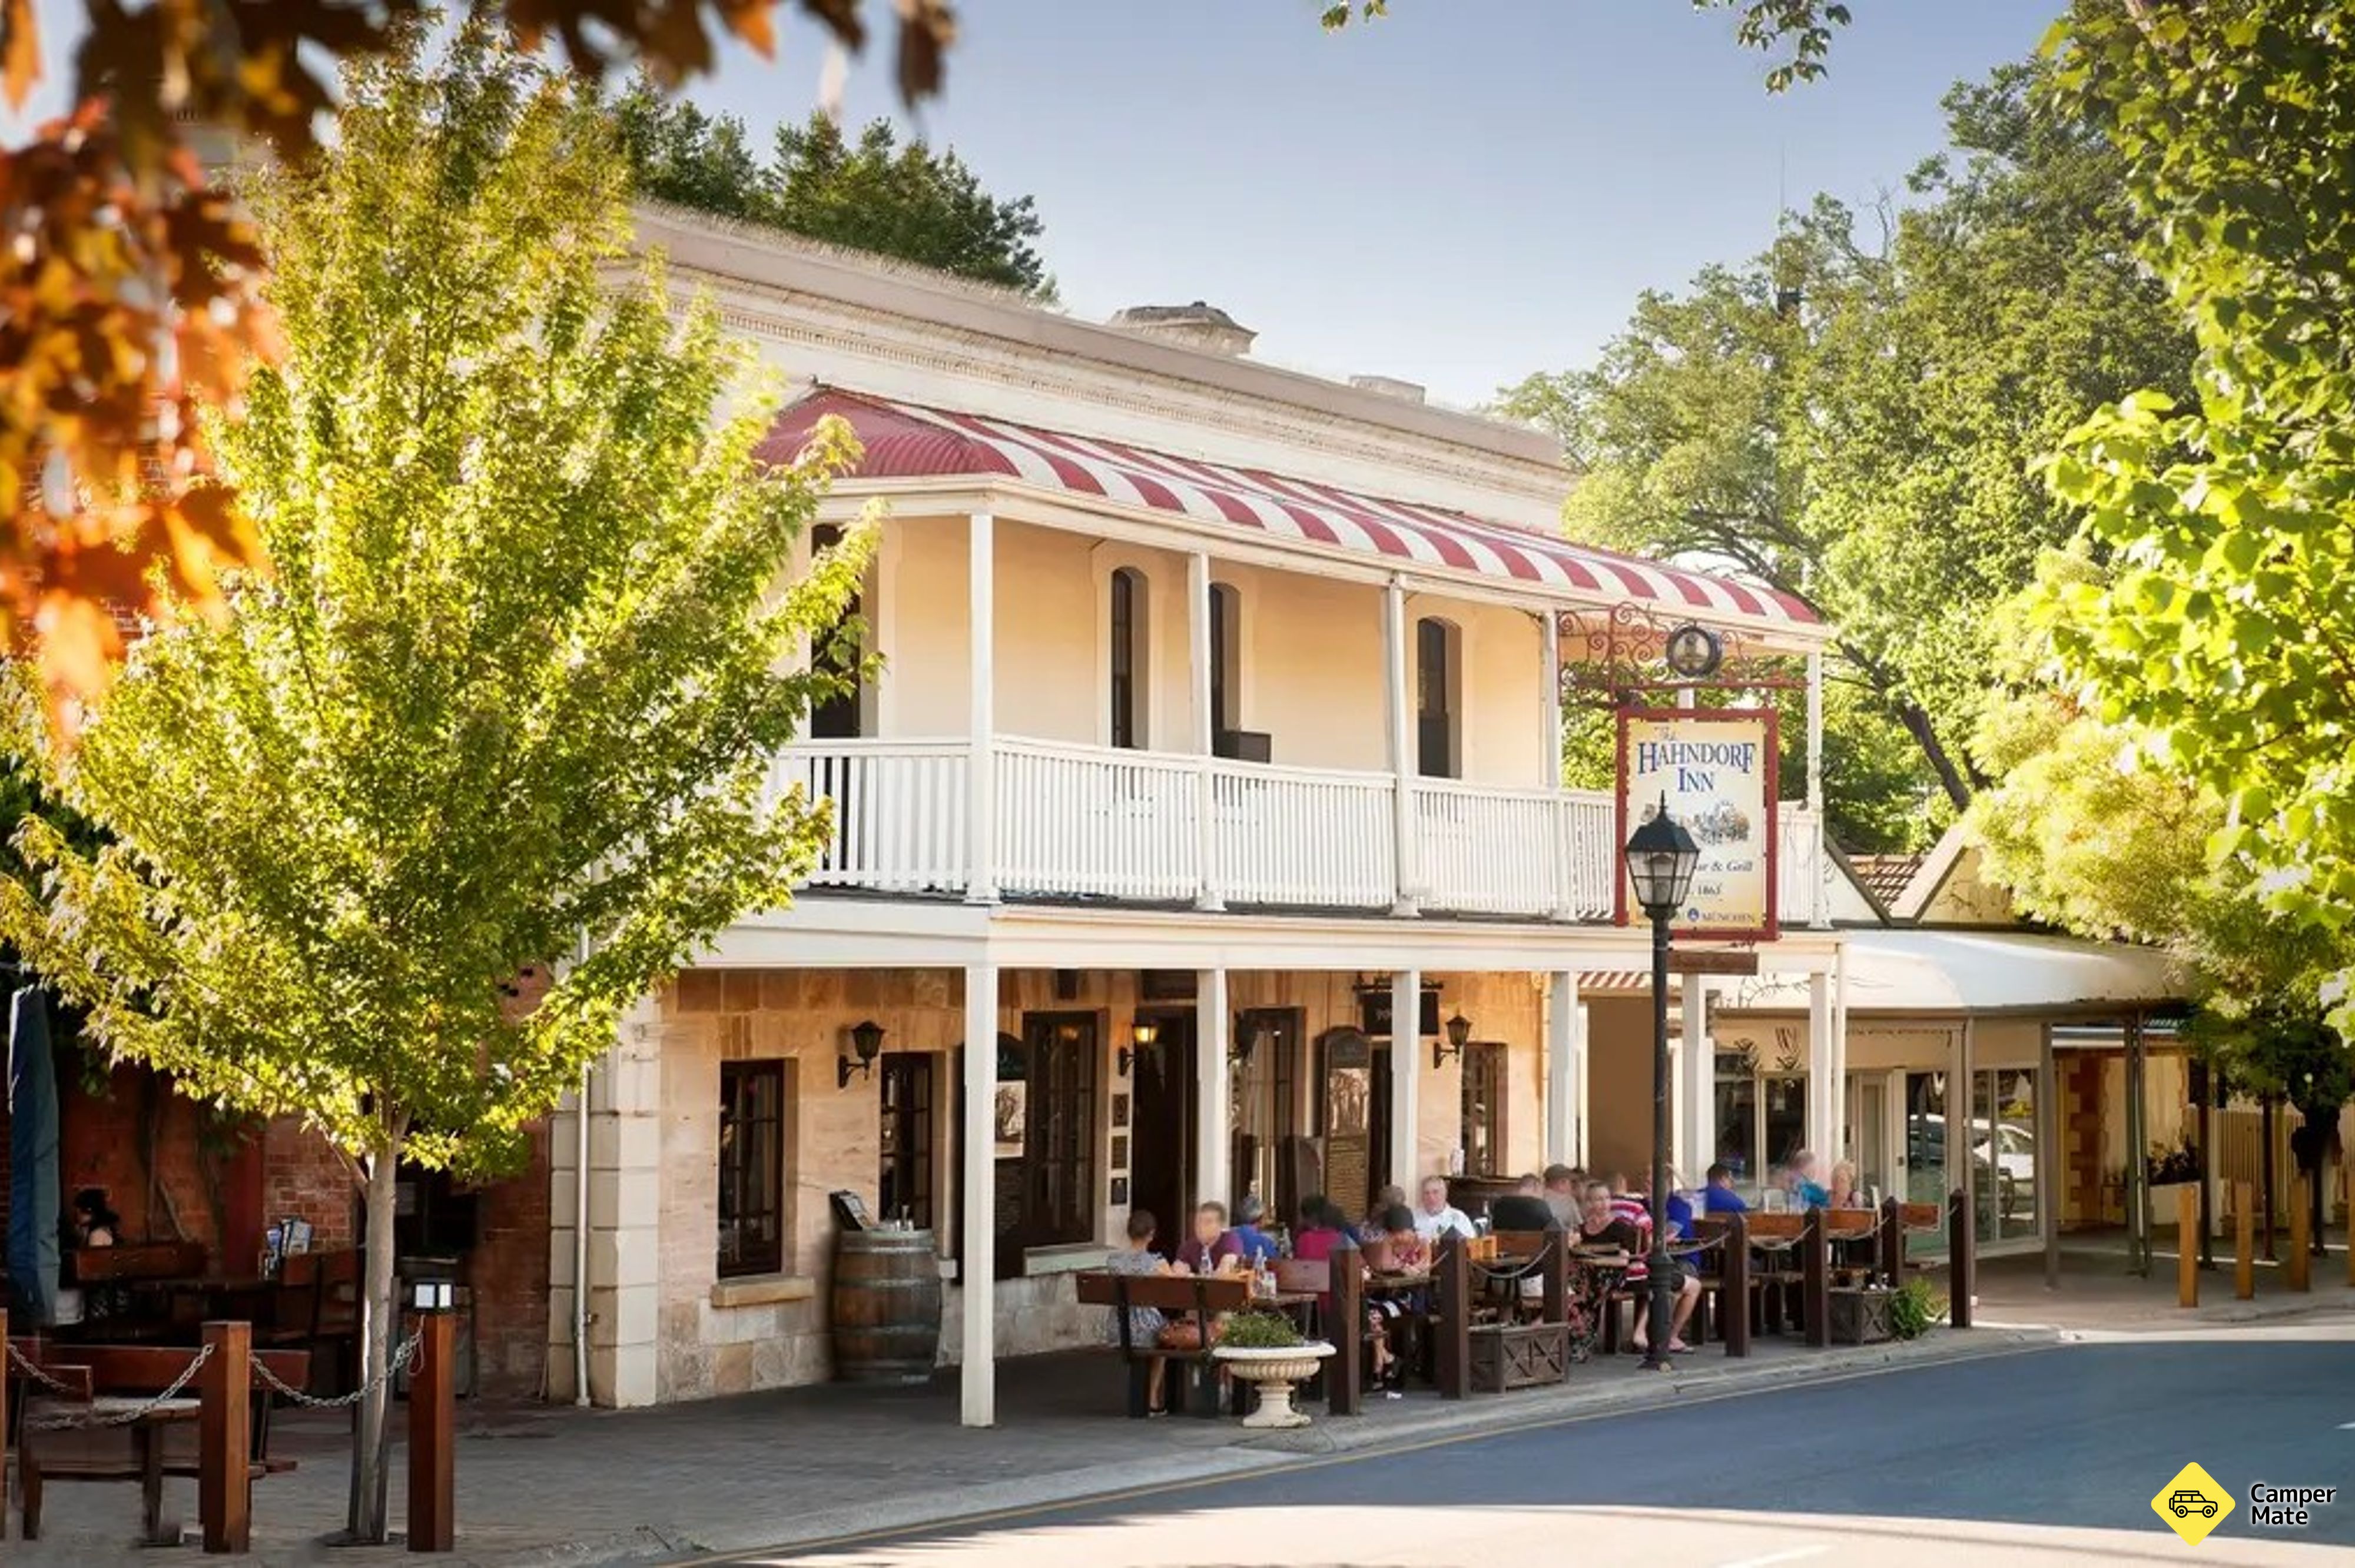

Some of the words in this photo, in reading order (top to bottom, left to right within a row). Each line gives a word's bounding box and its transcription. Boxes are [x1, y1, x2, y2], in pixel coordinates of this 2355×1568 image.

[1638, 742, 1757, 774] HAHNDORF
[1678, 767, 1713, 792] INN
[1710, 860, 1723, 872] &
[1726, 860, 1753, 872] Grill
